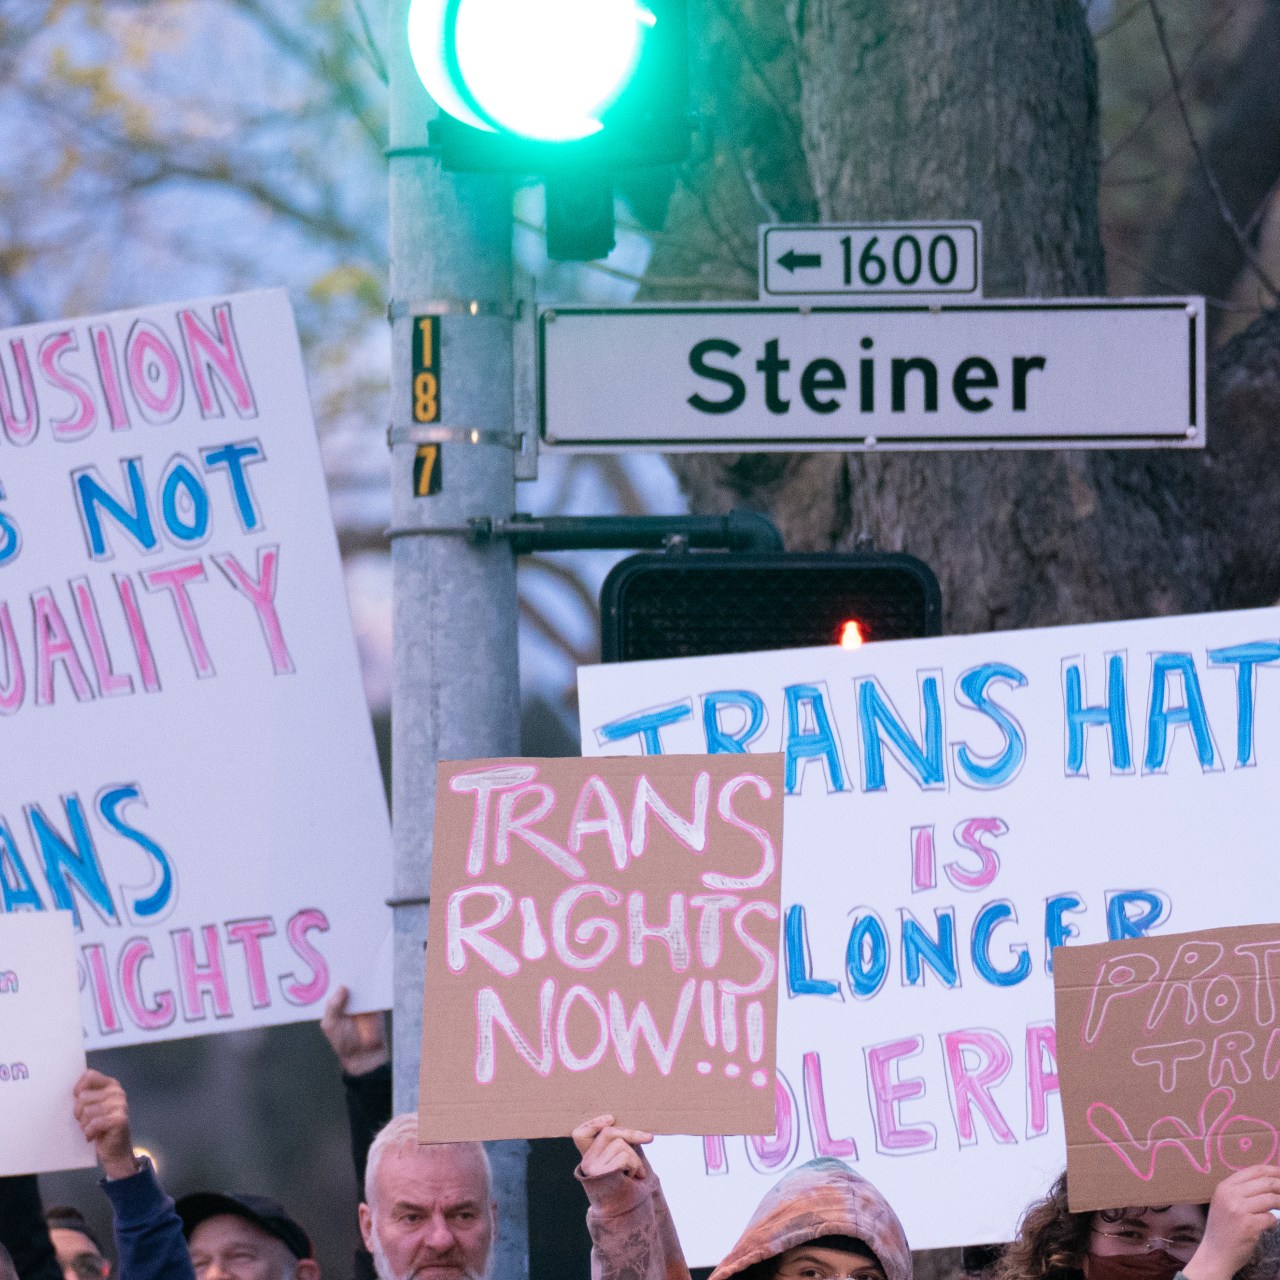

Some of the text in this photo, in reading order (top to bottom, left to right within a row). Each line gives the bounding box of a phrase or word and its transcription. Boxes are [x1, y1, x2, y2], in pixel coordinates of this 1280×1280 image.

[839, 233, 959, 287] 1600
[686, 336, 1047, 415] Steiner
[70, 438, 268, 561] NOT
[593, 662, 1028, 796] TRANS
[450, 764, 776, 889] TRANS
[910, 816, 1009, 893] IS
[79, 908, 330, 1036] IGHTS
[444, 882, 780, 995] RIGHTS
[784, 889, 1171, 1002] LONGER
[475, 976, 768, 1087] NOW!!!
[703, 1019, 1059, 1176] OLERA
